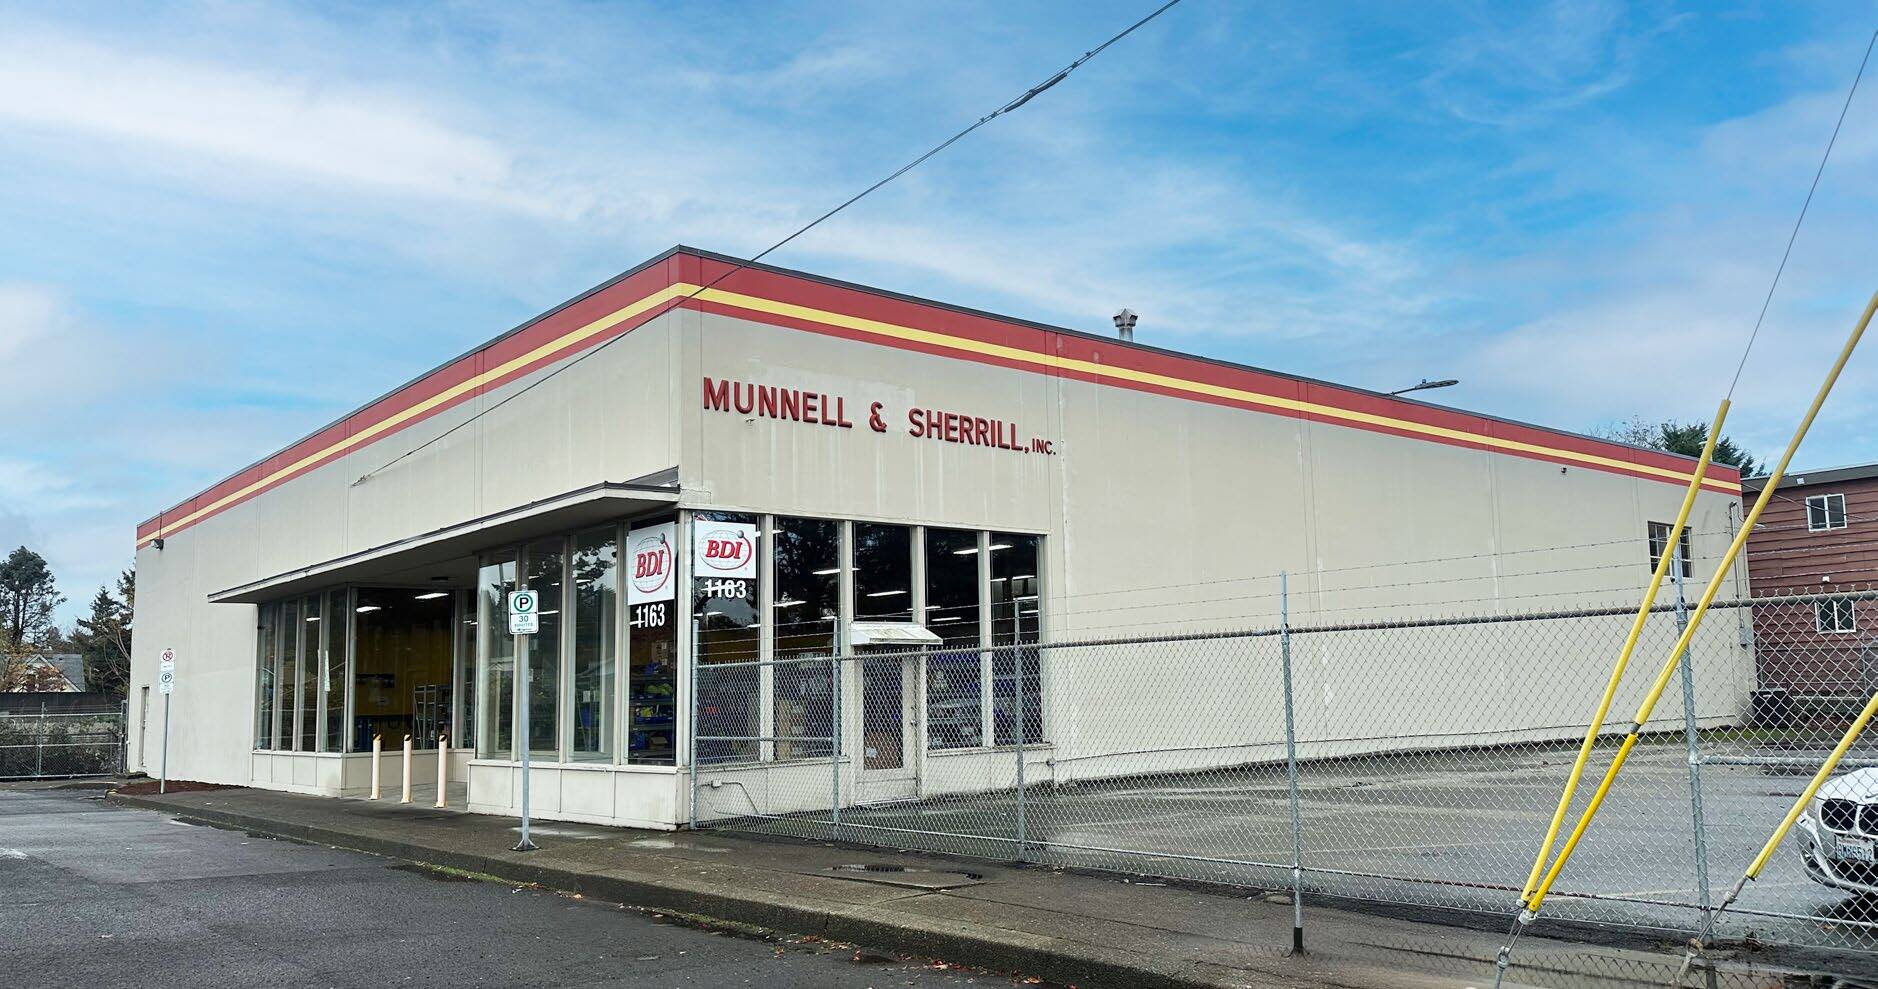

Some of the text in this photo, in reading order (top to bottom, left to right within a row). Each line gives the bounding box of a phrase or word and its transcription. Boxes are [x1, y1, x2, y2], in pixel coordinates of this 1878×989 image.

[703, 376, 1056, 456] MUNNELL & SHERRILL, INC.
[705, 540, 742, 559] BDI
[635, 550, 664, 579] BDI
[705, 579, 747, 598] 1163
[519, 597, 529, 609] P
[518, 615, 529, 623] 30
[636, 603, 665, 628] 1163
